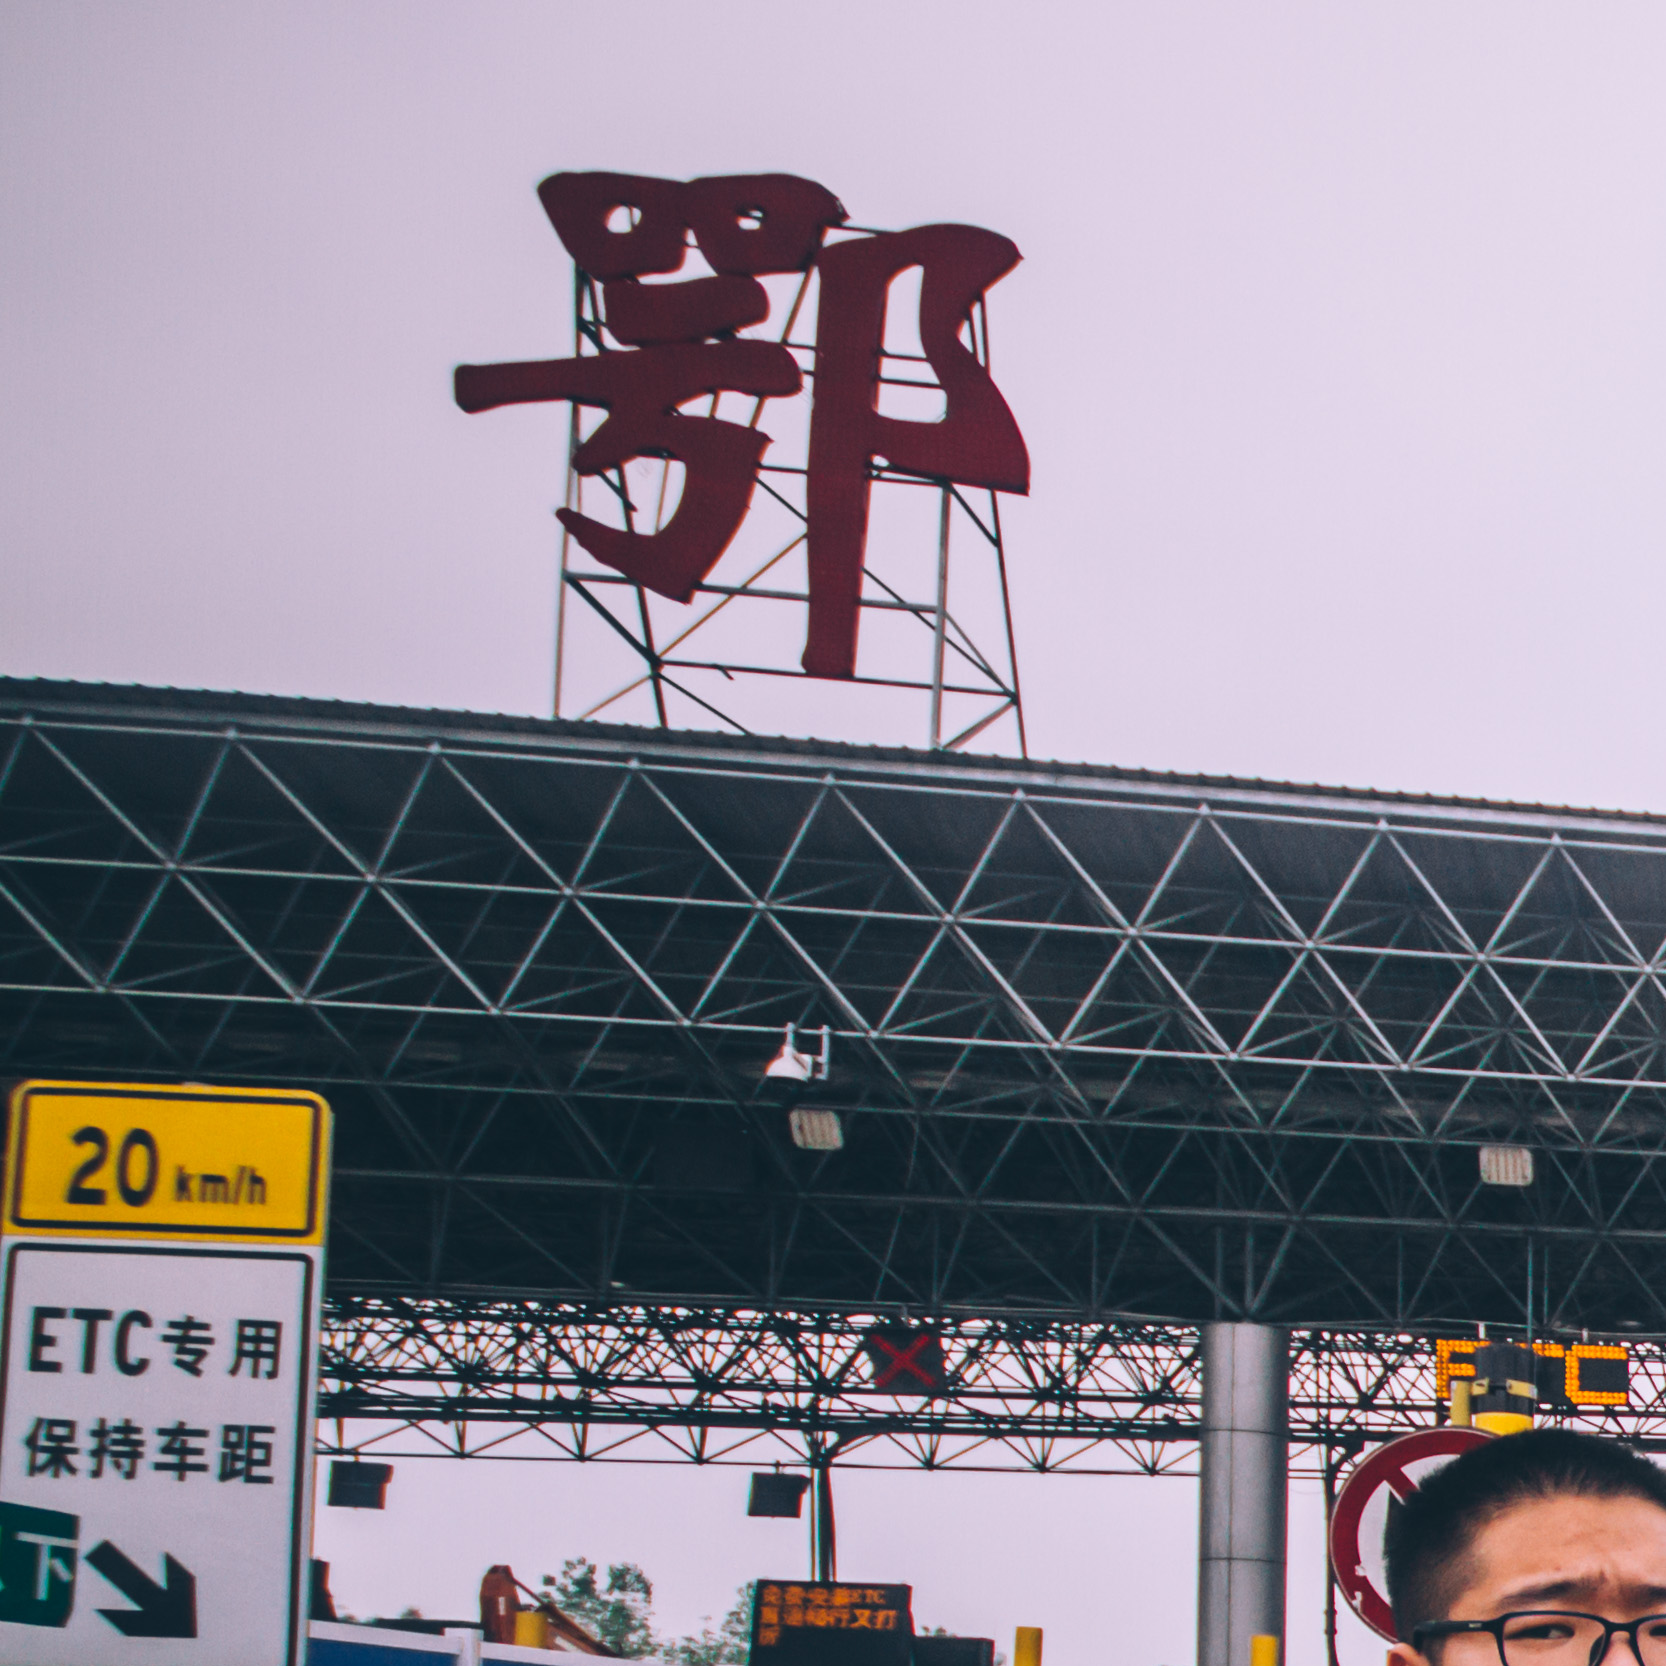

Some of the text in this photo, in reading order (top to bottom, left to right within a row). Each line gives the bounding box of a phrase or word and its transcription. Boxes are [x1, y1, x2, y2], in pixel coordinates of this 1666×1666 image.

[454, 171, 1031, 678] 鄂
[67, 1126, 269, 1207] 20 km/h
[28, 1305, 282, 1381] ETC专用
[23, 1416, 276, 1486] 保持车距
